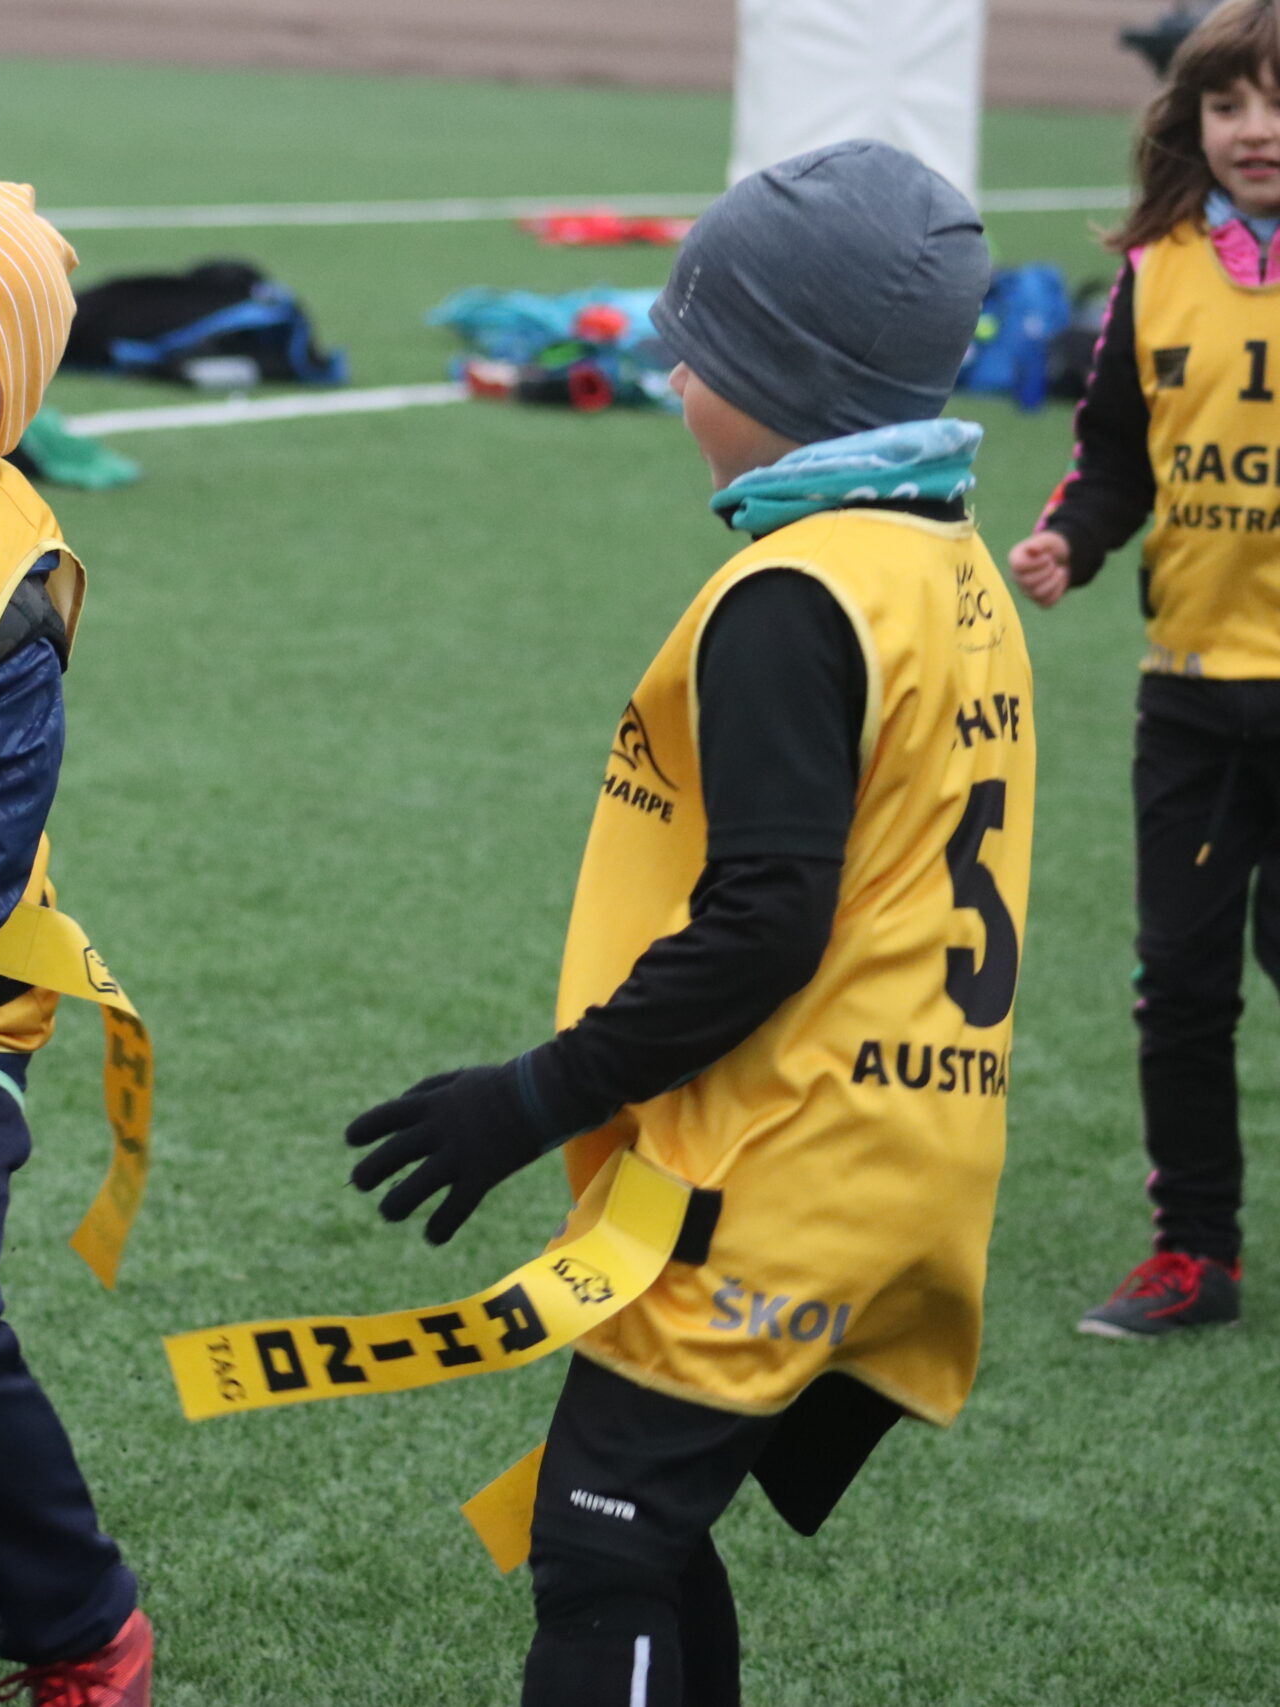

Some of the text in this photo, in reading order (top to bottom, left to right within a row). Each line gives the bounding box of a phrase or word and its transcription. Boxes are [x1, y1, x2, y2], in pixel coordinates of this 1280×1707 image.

[1239, 340, 1274, 402] 1
[1170, 443, 1280, 486] RAG
[945, 779, 1019, 1028] 5
